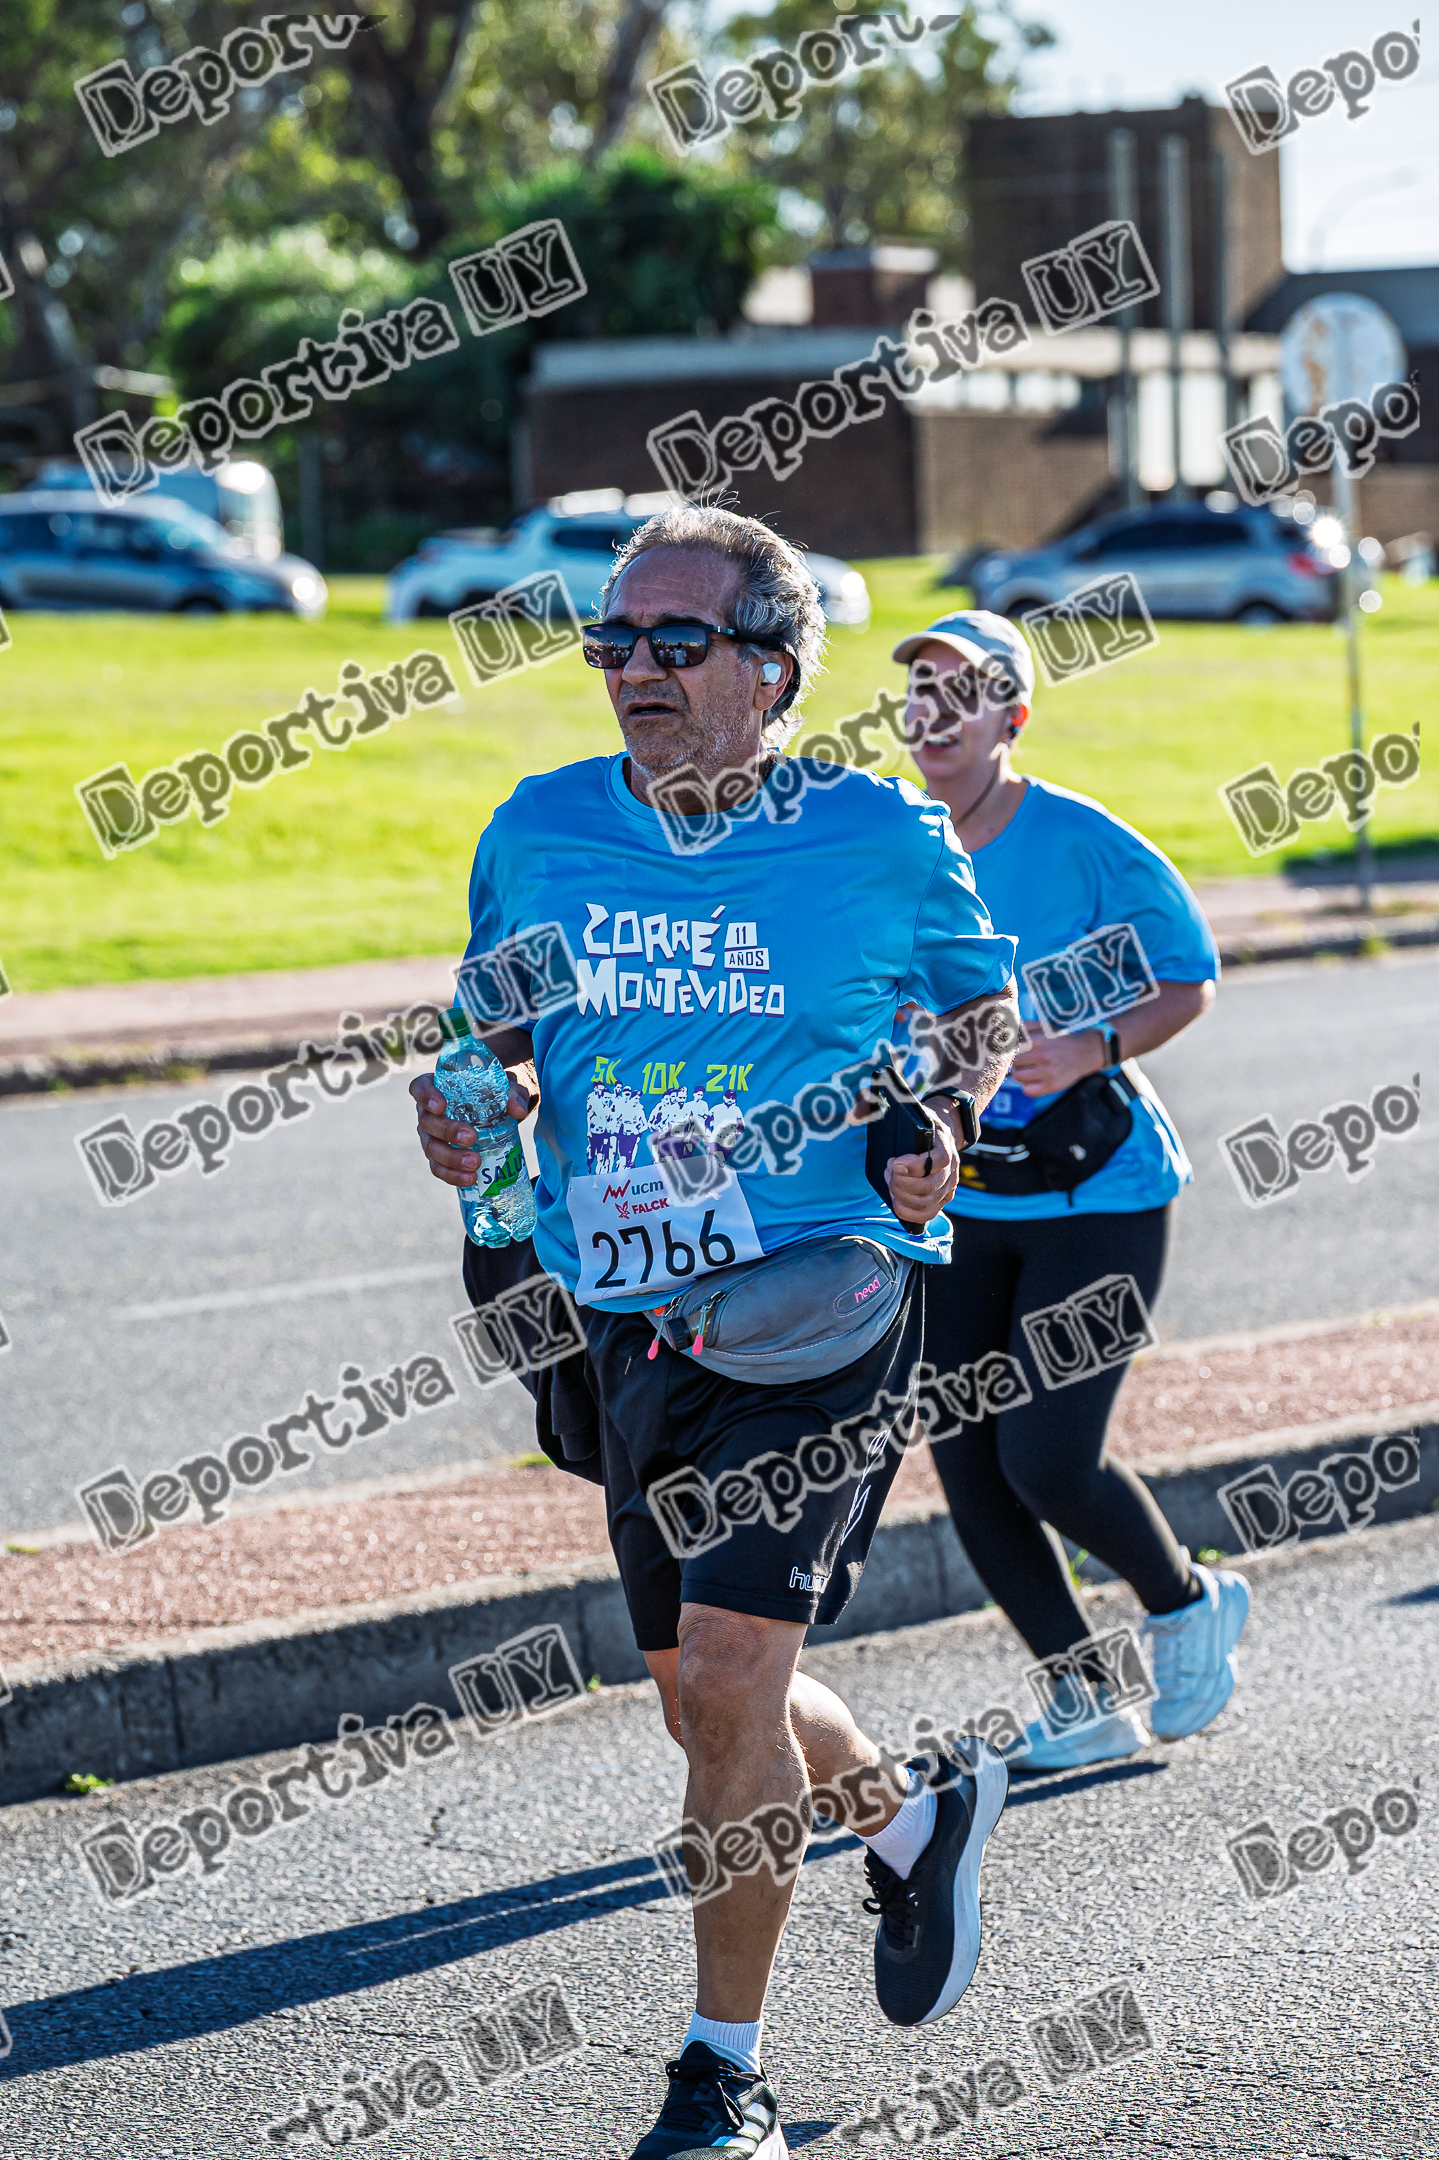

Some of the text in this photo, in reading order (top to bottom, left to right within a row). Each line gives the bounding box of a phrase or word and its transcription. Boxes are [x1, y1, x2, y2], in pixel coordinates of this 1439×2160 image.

[735, 926, 747, 945] 11
[729, 951, 765, 968] AÑOS
[577, 957, 786, 1018] MONTEVIDEO
[591, 1056, 755, 1095] 5K 10K 21K
[631, 1180, 664, 1196] ucm
[631, 1197, 670, 1215] FALCK
[591, 1208, 737, 1290] 2766
[854, 1275, 881, 1304] head
